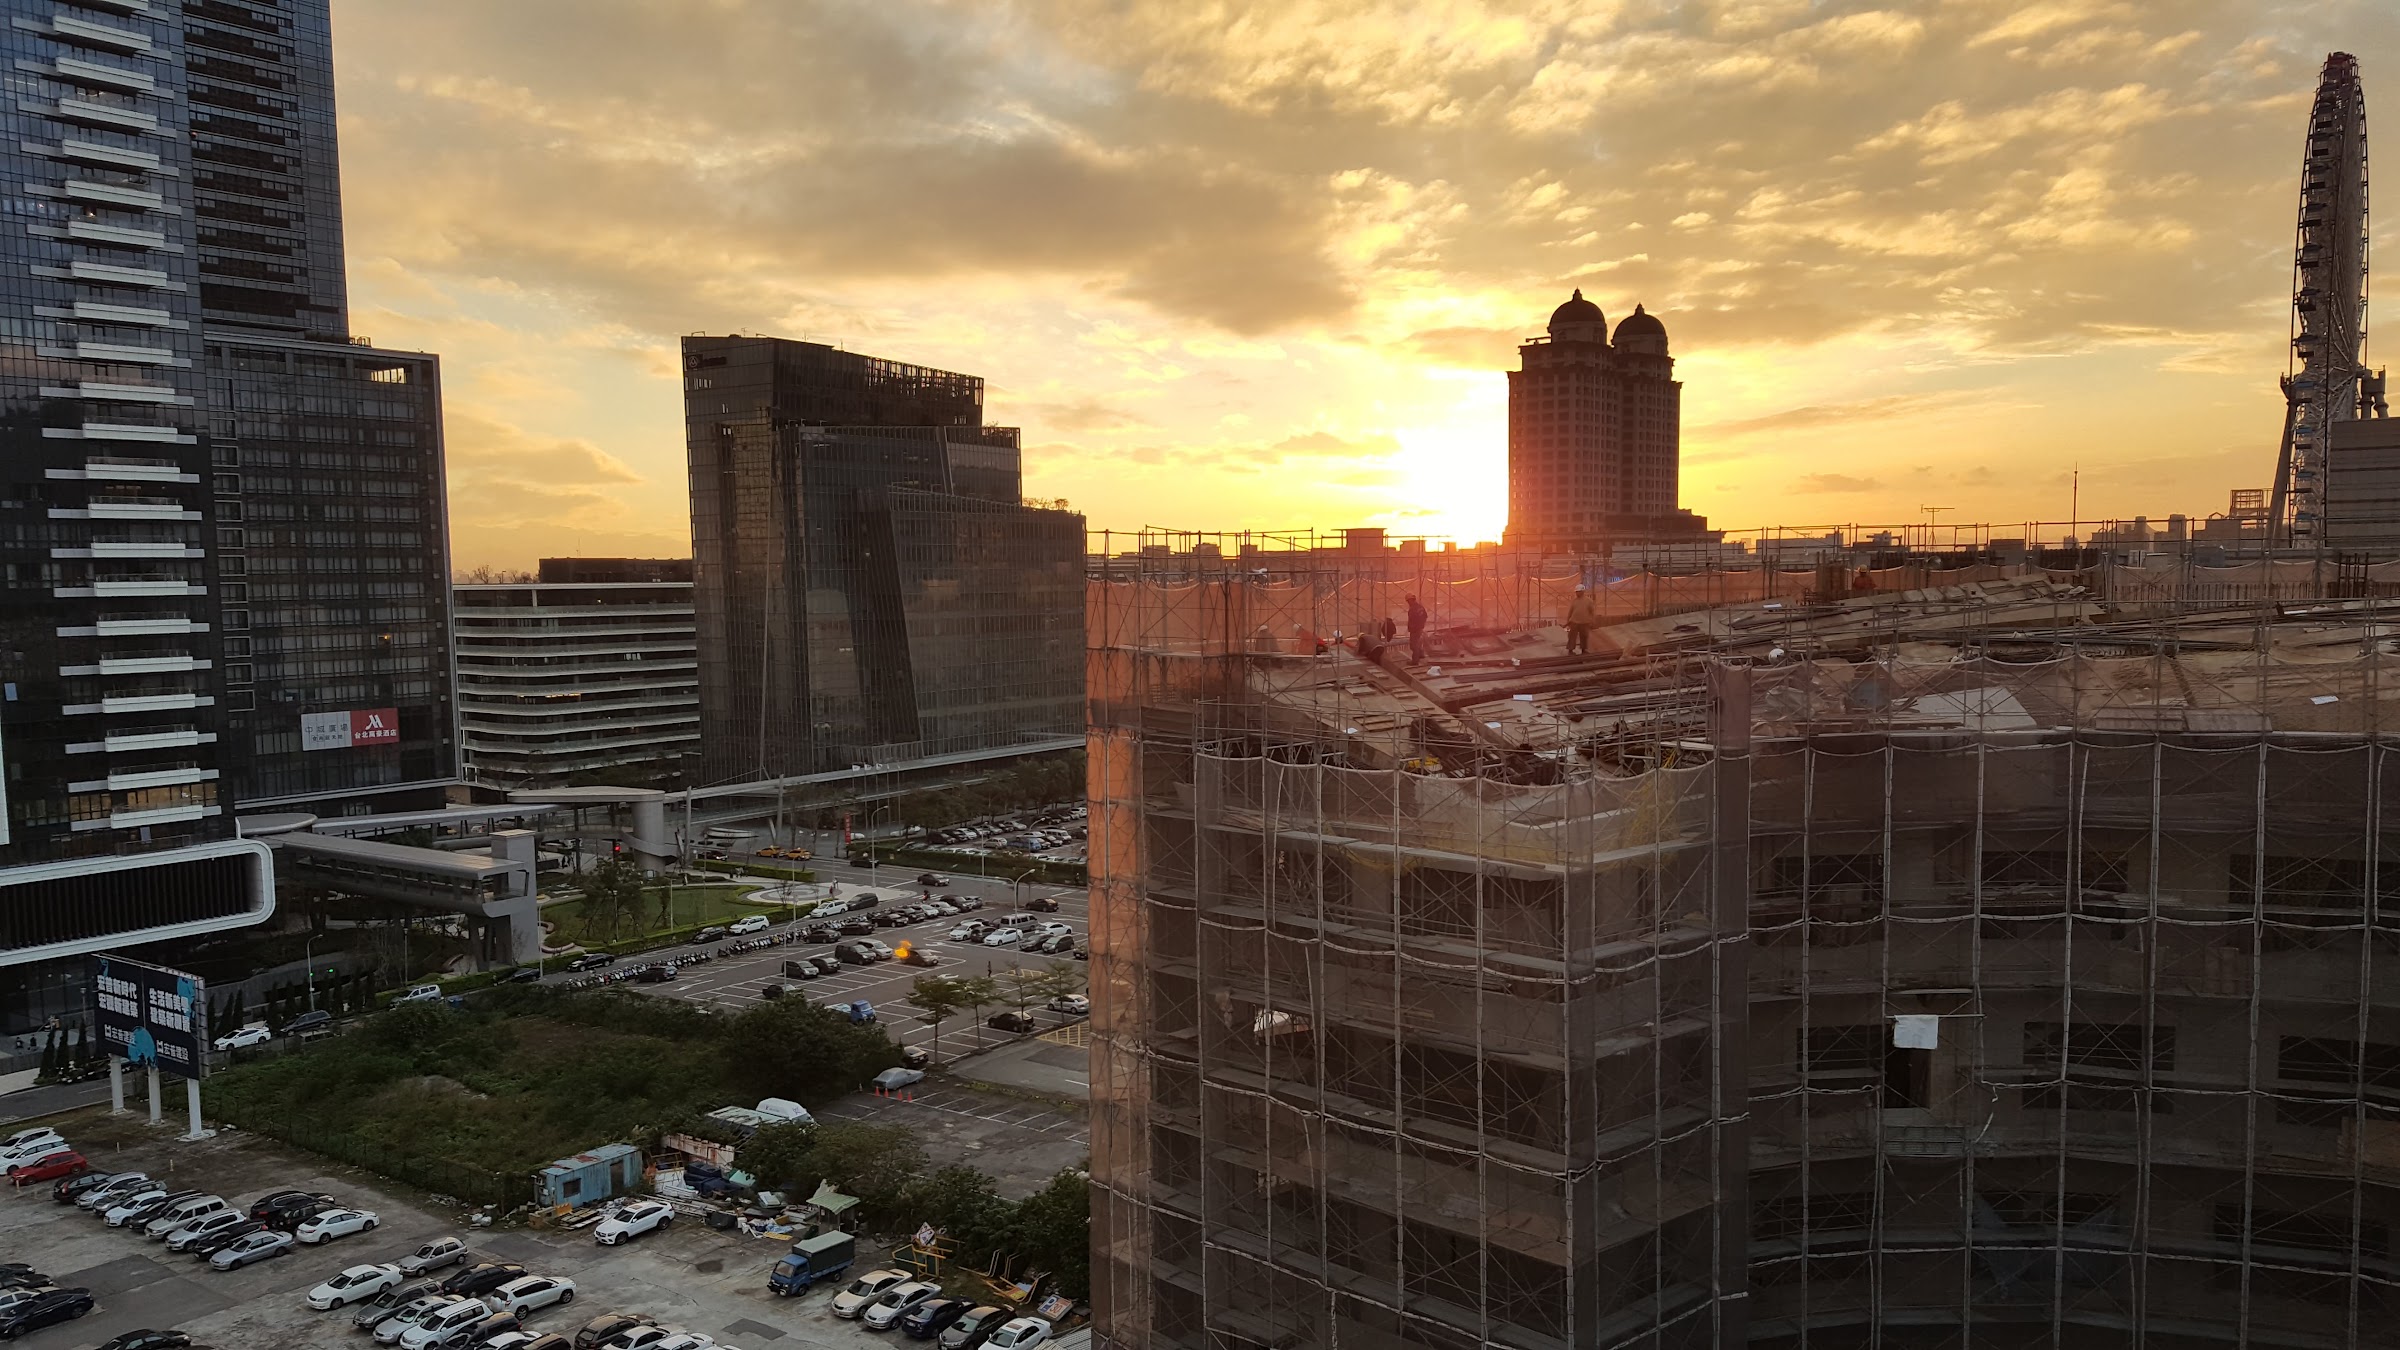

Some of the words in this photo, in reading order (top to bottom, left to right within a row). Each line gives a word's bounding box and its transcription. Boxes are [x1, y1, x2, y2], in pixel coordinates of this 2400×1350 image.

[149, 988, 189, 1013] 生活新美學
